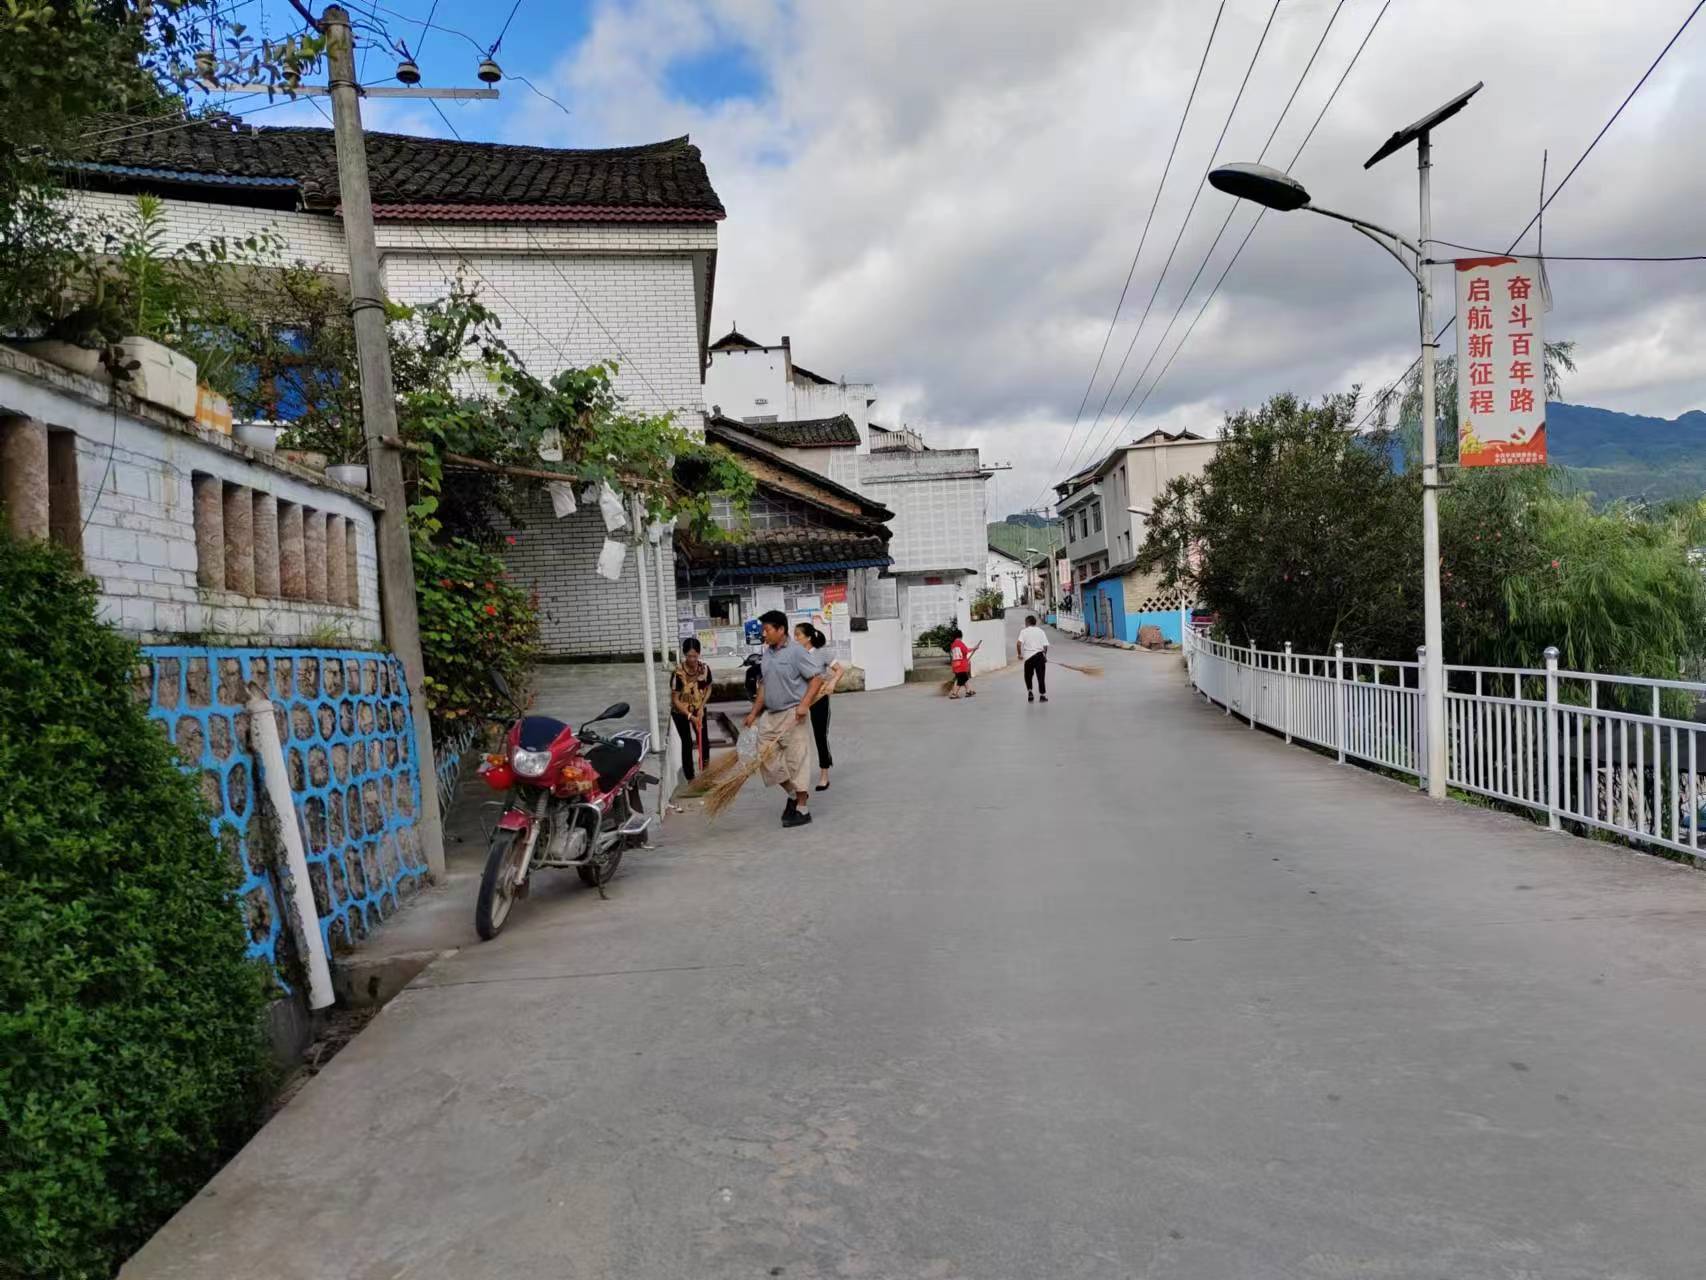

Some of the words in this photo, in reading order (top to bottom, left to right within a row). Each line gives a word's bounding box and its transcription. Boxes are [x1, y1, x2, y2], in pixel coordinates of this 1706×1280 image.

[1467, 277, 1494, 414] 启航新征程
[1507, 275, 1534, 413] 奋斗百年路
